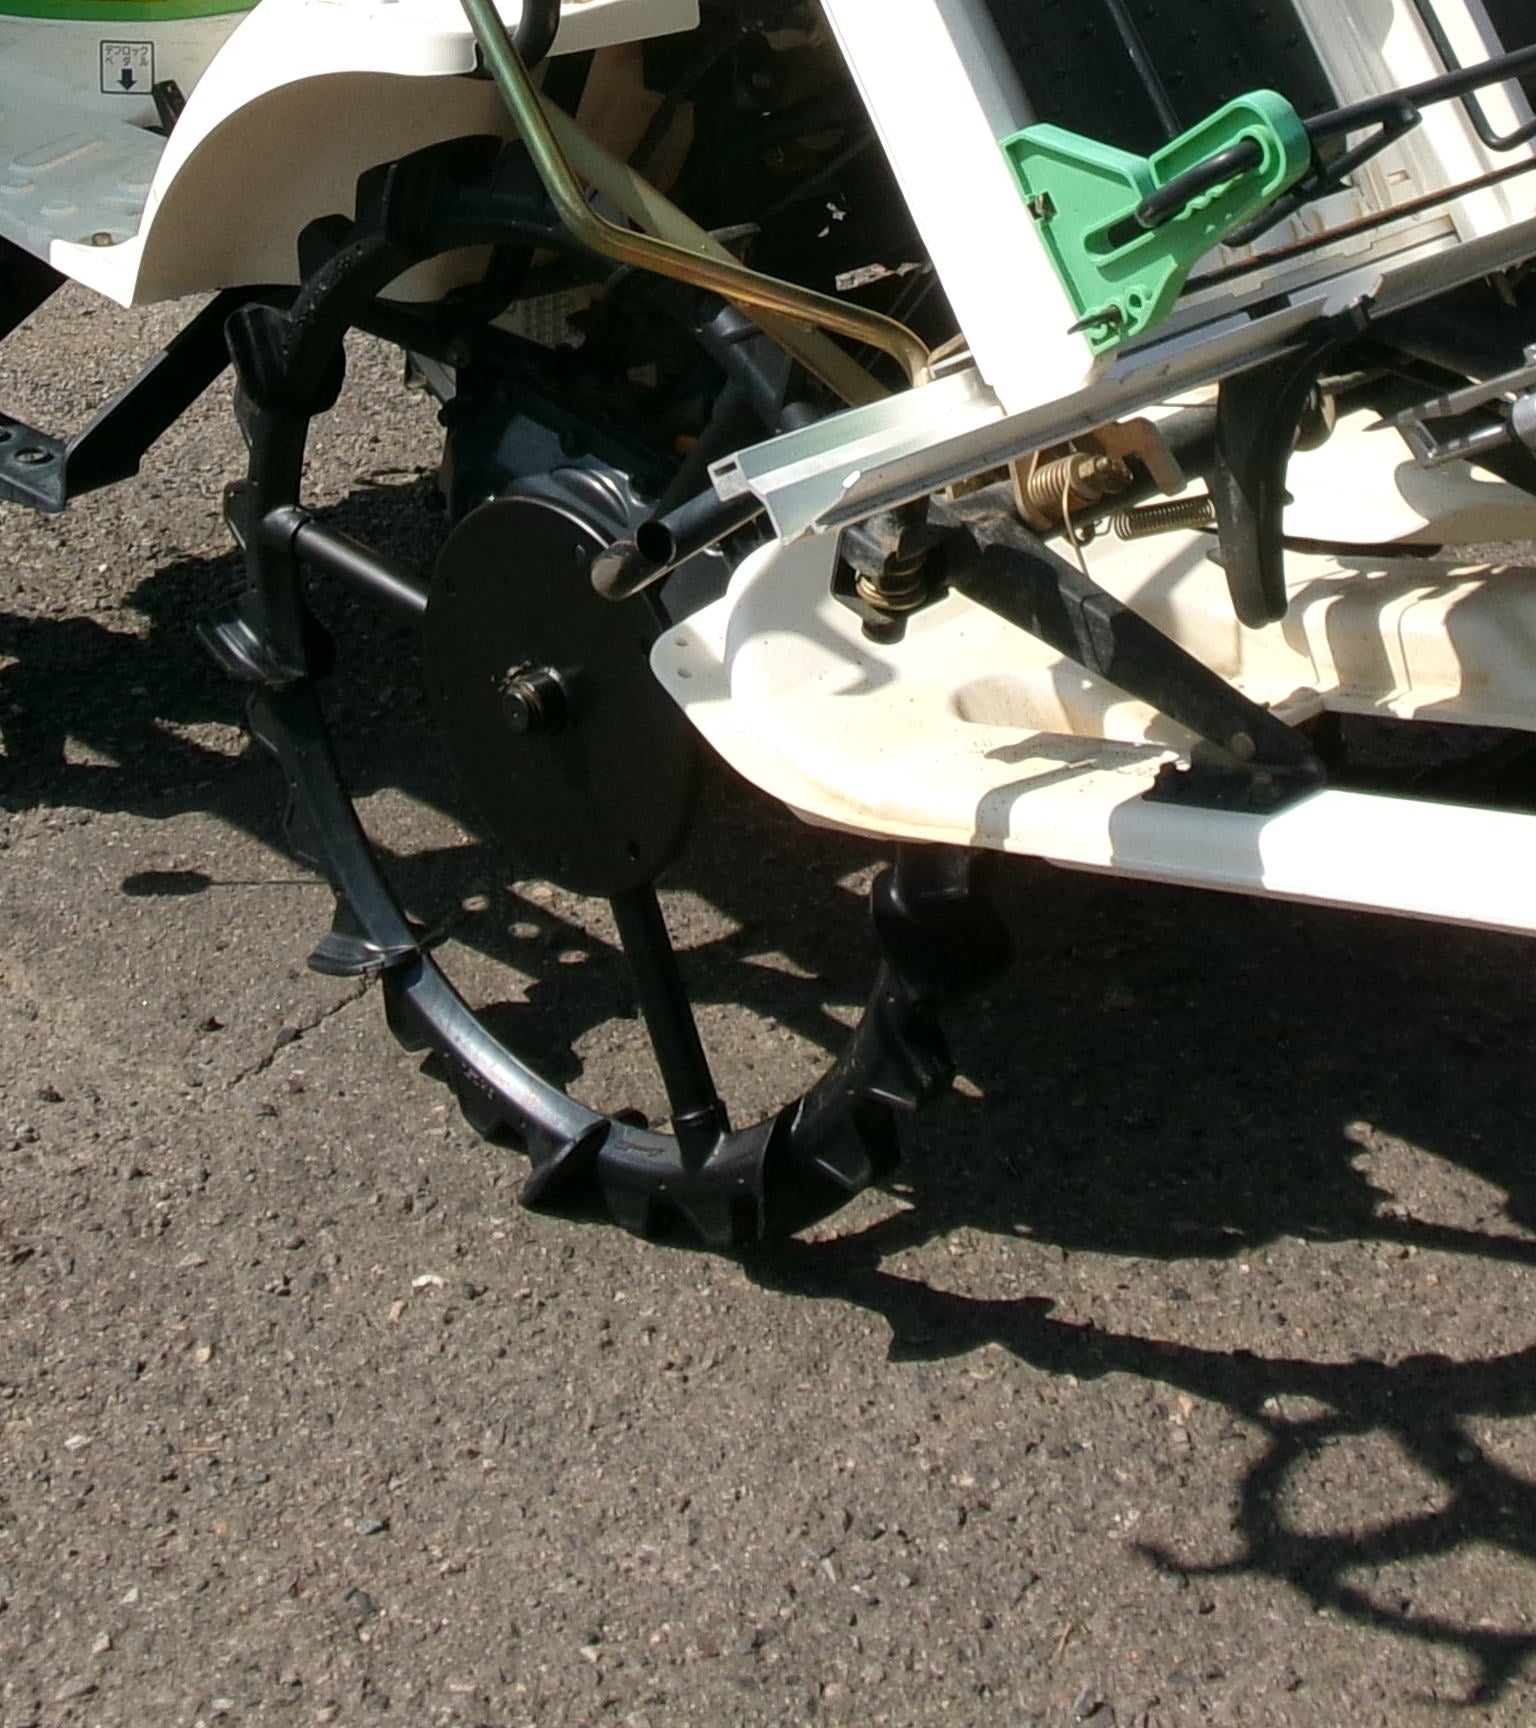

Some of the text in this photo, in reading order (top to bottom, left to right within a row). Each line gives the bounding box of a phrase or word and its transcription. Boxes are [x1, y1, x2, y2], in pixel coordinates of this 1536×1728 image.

[105, 44, 149, 56] デフロック
[105, 56, 149, 67] ペダル
